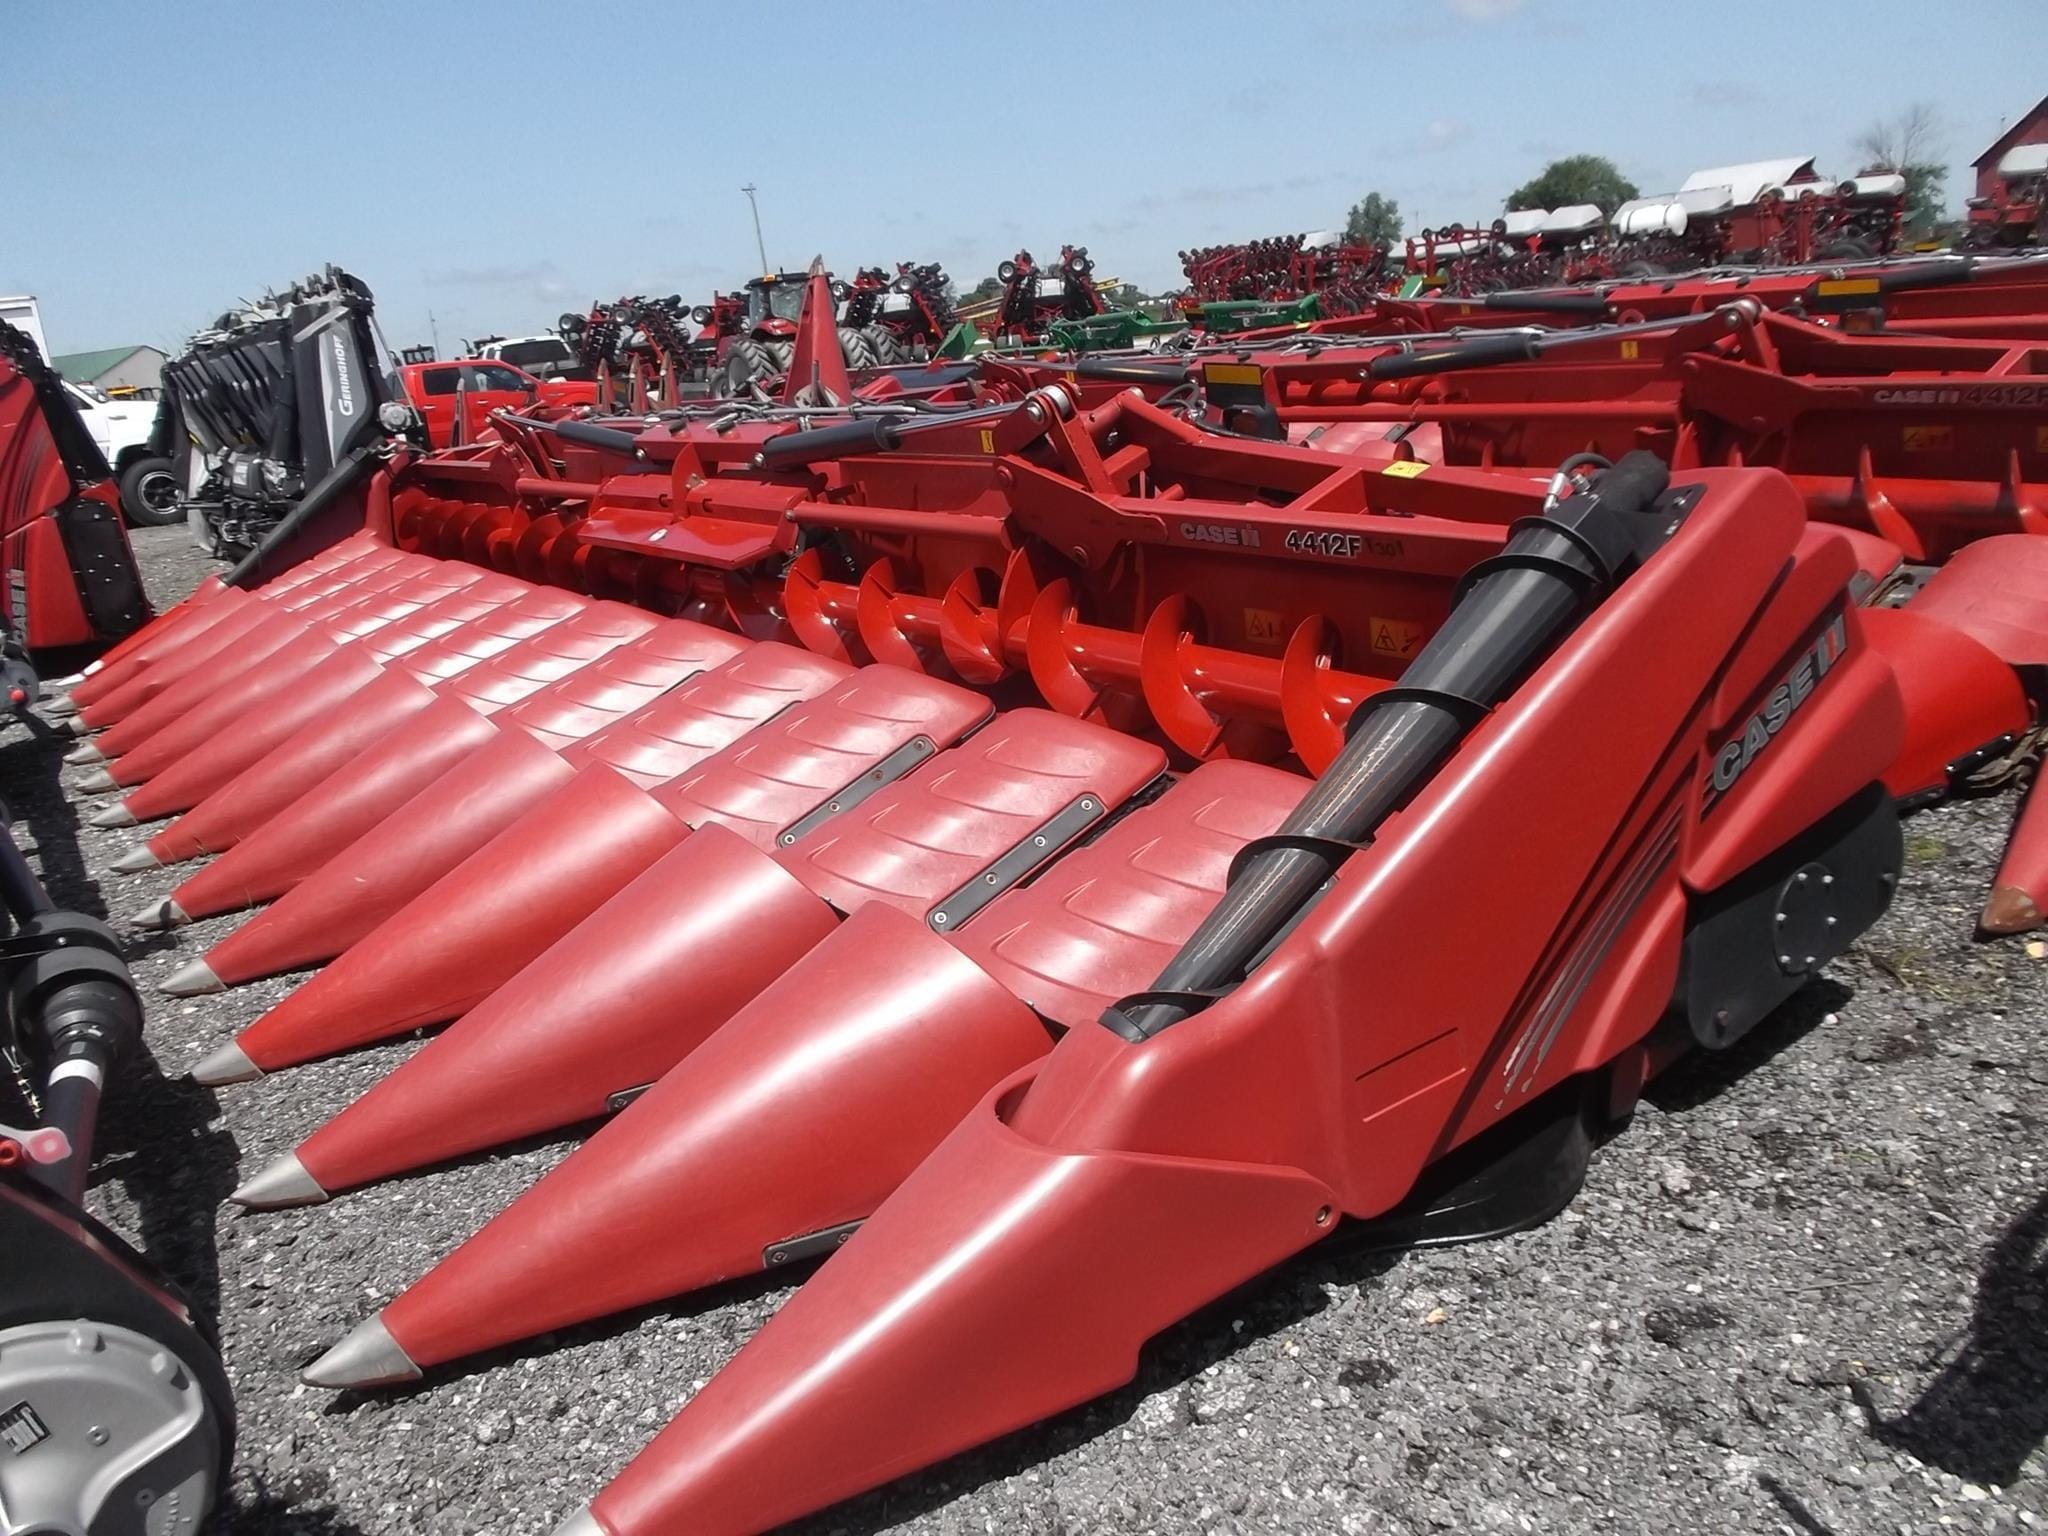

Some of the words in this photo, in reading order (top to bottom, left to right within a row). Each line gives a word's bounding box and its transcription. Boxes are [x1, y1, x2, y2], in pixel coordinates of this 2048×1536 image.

[1873, 389, 1937, 404] CASE
[1179, 522, 1238, 545] CASE
[1285, 529, 1361, 558] 4412F
[1713, 653, 1815, 791] CASE
